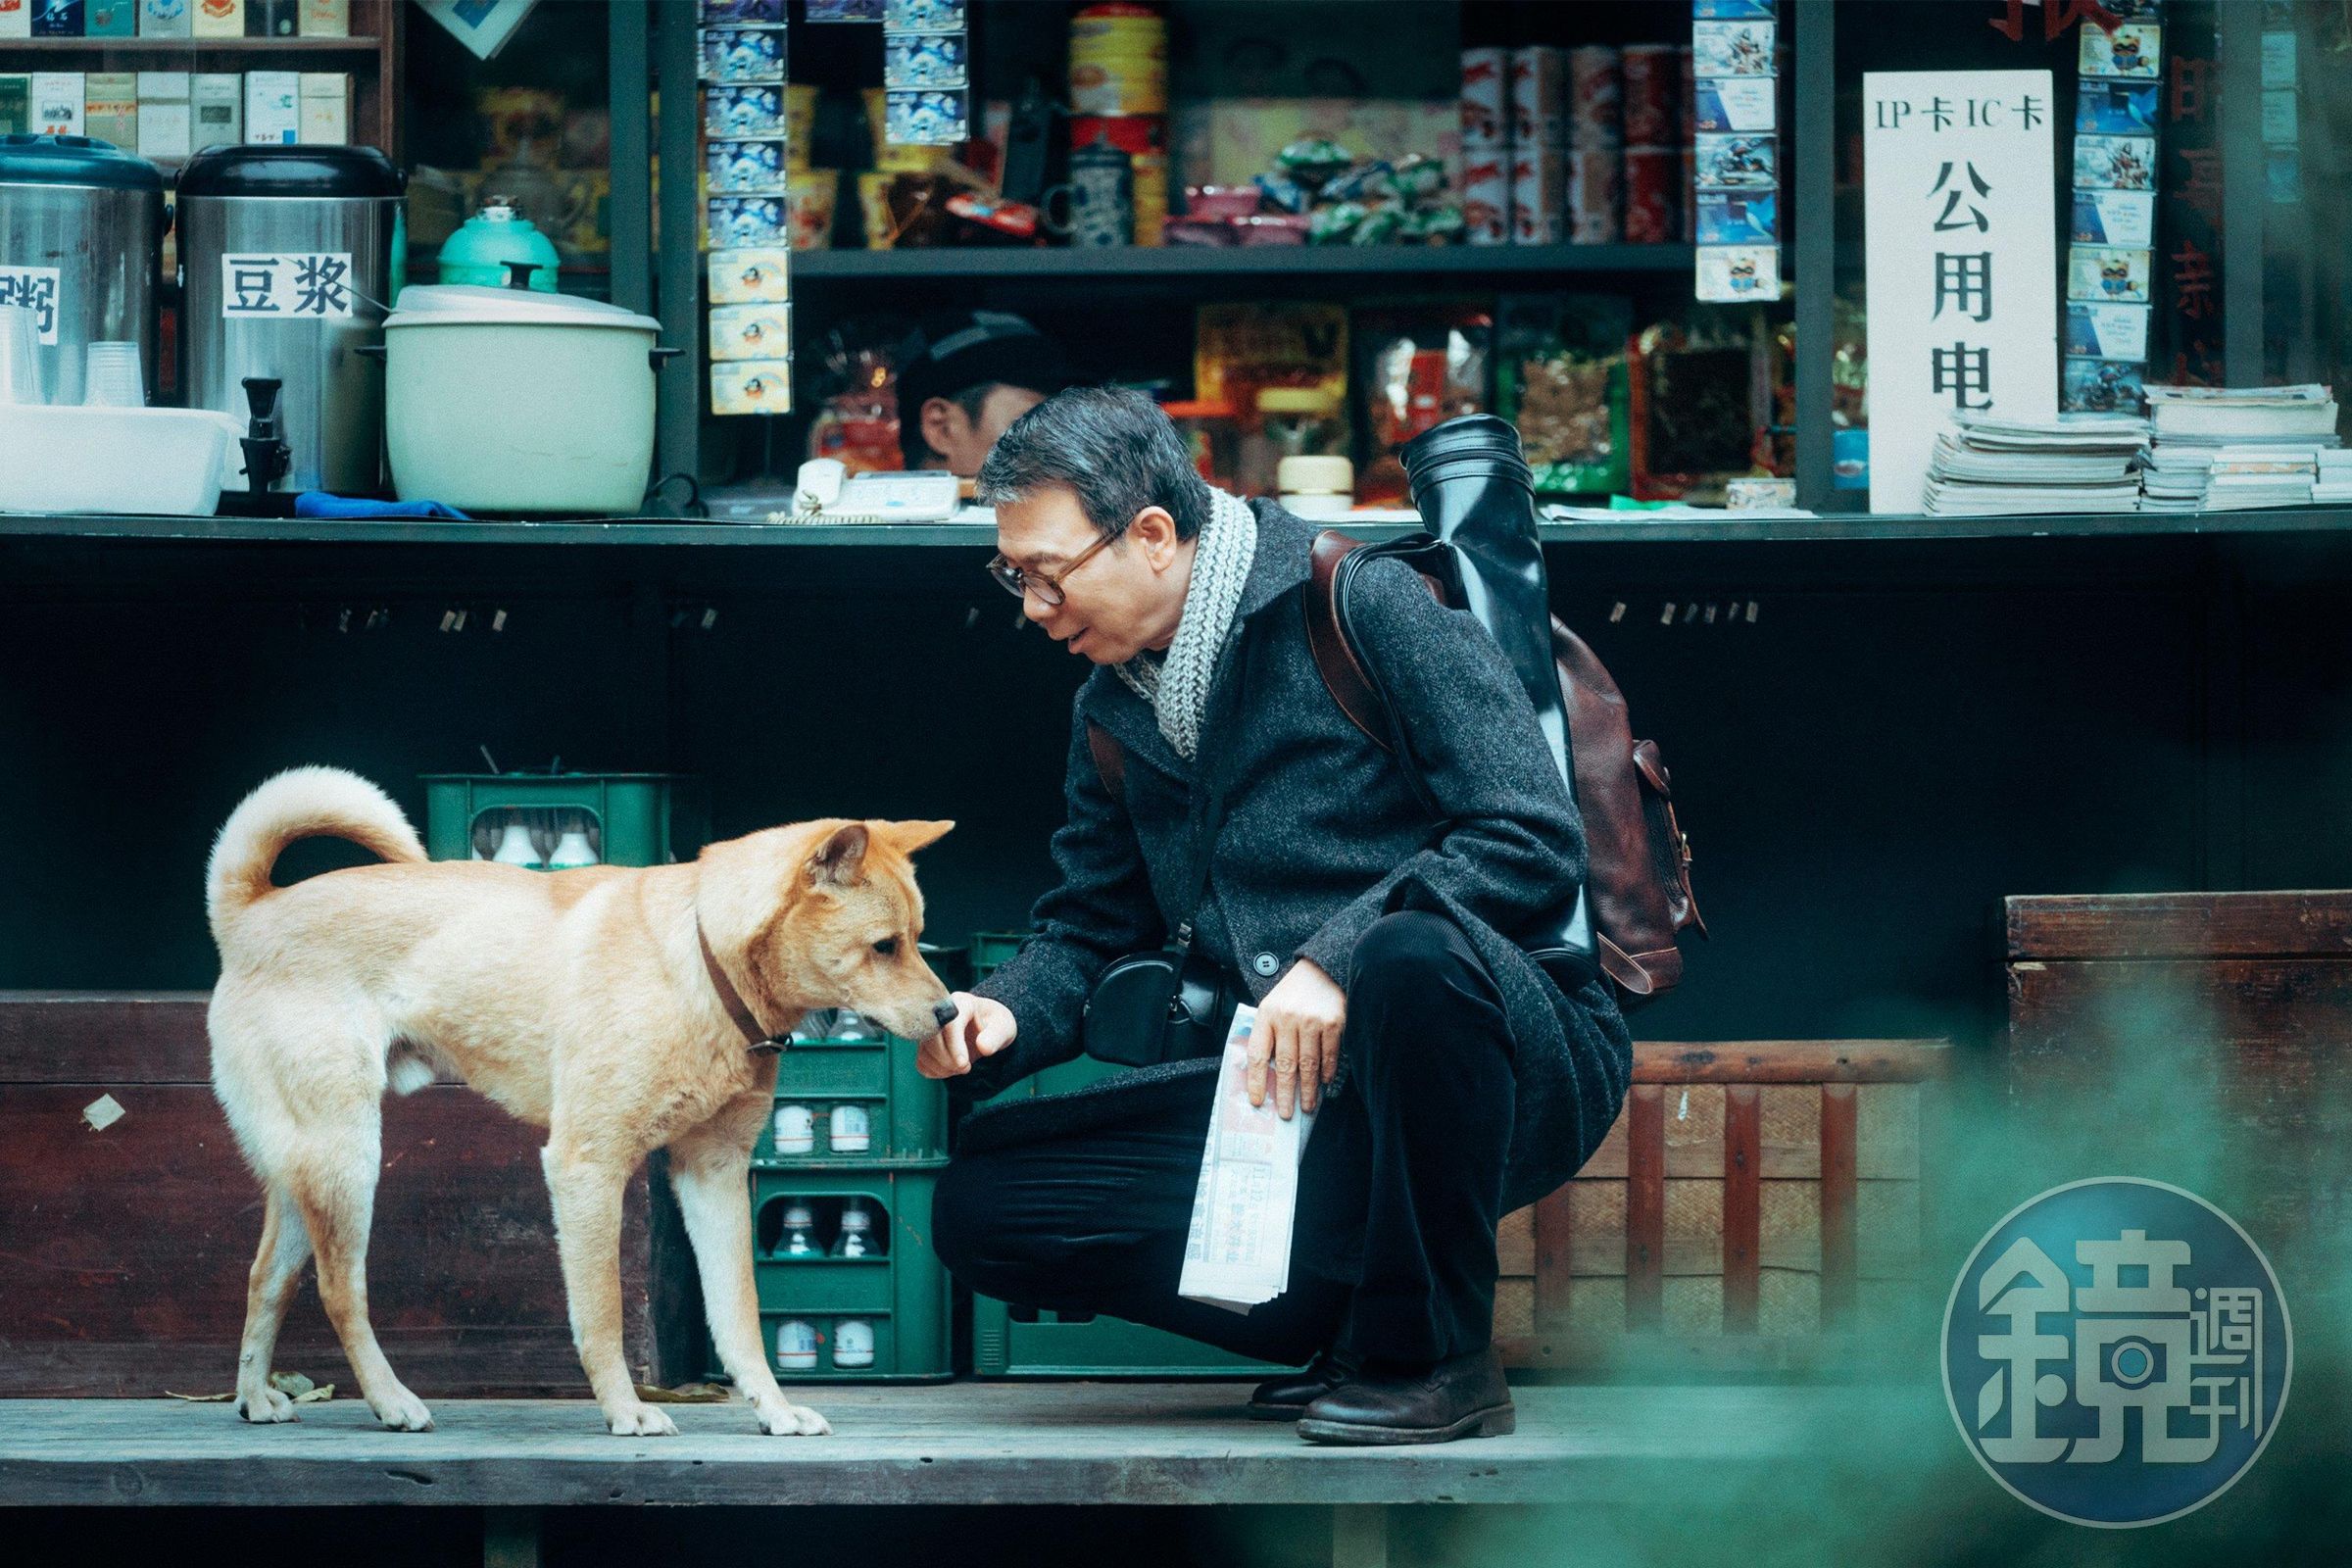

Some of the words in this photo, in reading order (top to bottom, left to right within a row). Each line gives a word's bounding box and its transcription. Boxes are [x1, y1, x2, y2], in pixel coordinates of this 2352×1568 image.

[228, 256, 349, 315] 豆浆
[1927, 161, 1994, 411] 公用电
